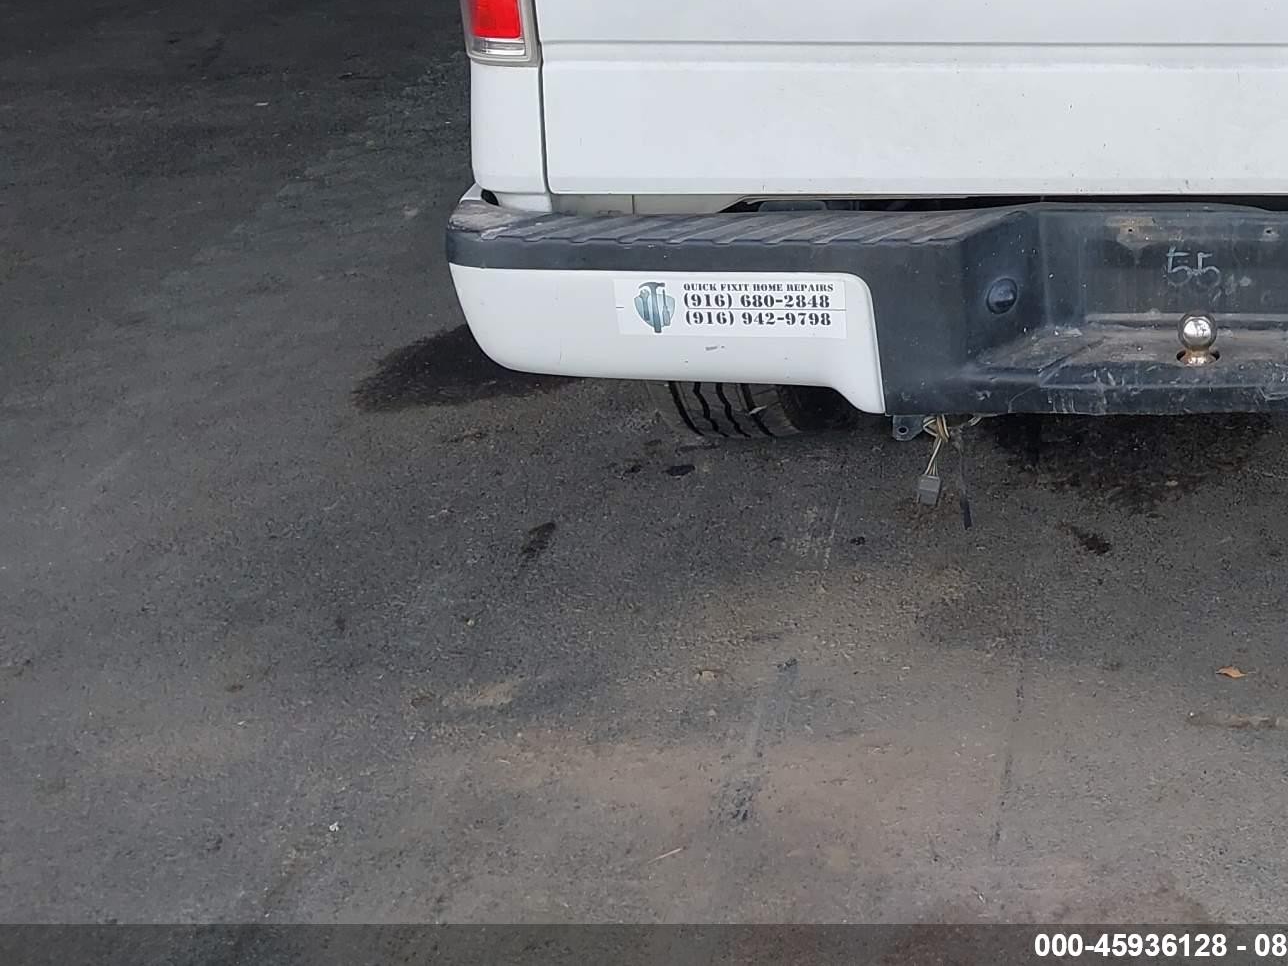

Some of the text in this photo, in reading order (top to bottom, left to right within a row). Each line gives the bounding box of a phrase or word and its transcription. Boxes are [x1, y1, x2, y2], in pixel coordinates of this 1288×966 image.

[683, 283, 834, 292] QUICK FIXIT HOME REPAIRS
[684, 293, 831, 309] (916) 680-2848
[685, 311, 832, 326] (916) 942-9798
